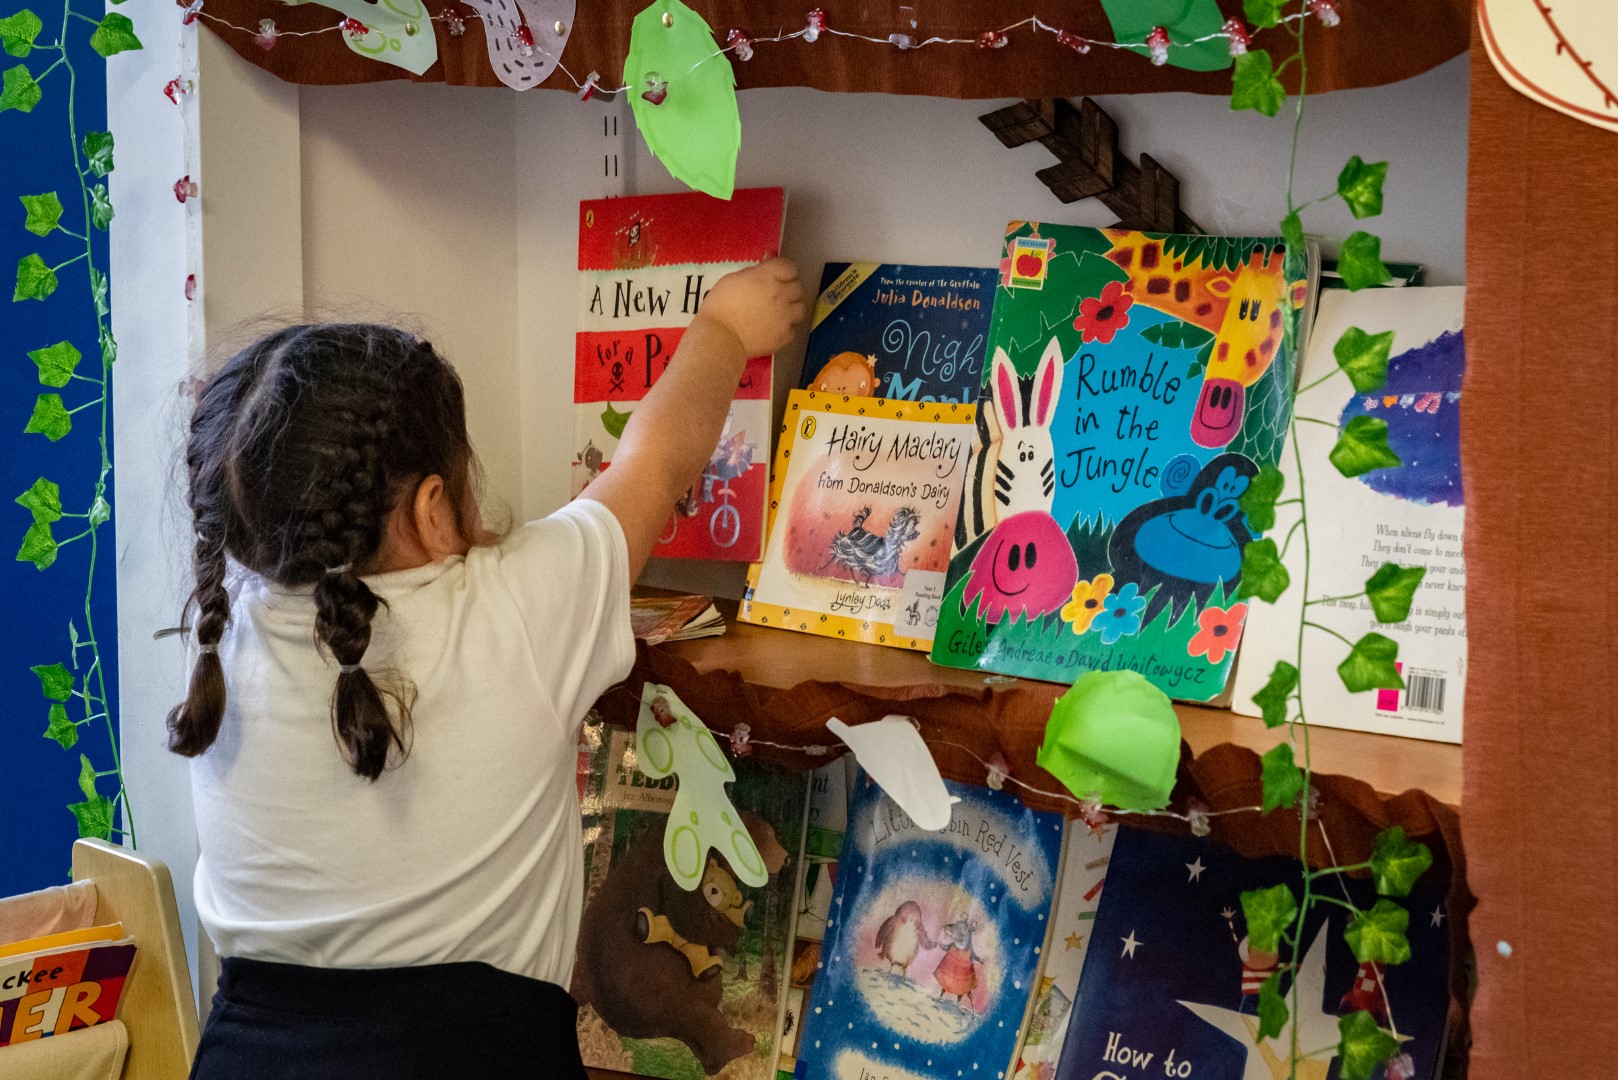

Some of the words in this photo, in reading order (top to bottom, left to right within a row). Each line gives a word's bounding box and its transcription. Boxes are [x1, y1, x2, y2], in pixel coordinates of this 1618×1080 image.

[589, 284, 604, 315] A
[872, 289, 906, 306] Julia
[911, 289, 980, 311] Donaldson
[597, 339, 621, 368] for
[625, 346, 634, 366] a
[1076, 352, 1181, 405] Rumble
[1075, 407, 1100, 435] in
[1116, 405, 1160, 441] the
[825, 424, 883, 471] Hairy
[887, 431, 962, 479] Maclary
[1060, 446, 1160, 493] Jungle
[817, 472, 844, 491] from
[848, 477, 917, 499] Donaldson's
[920, 483, 950, 509] Dairy
[1376, 524, 1399, 537] When
[1401, 526, 1422, 539] aliens
[1424, 528, 1435, 541] fly
[1437, 529, 1458, 542] down
[1373, 539, 1391, 554] They
[1393, 541, 1412, 554] don't
[1414, 546, 1433, 556] come
[1435, 545, 1443, 556] to
[1361, 555, 1379, 569] They
[1429, 565, 1447, 575] your
[1425, 582, 1446, 590] never
[830, 590, 864, 614] Lynley
[865, 595, 891, 611] Dodd
[1415, 605, 1422, 616] is
[1424, 606, 1451, 620] simply
[1415, 623, 1433, 633] your
[1434, 625, 1456, 637] pants
[1065, 647, 1111, 672] David
[975, 819, 1008, 857] Red
[1005, 844, 1034, 892] Vest
[1102, 1031, 1154, 1070] How
[1164, 1048, 1192, 1078] to
